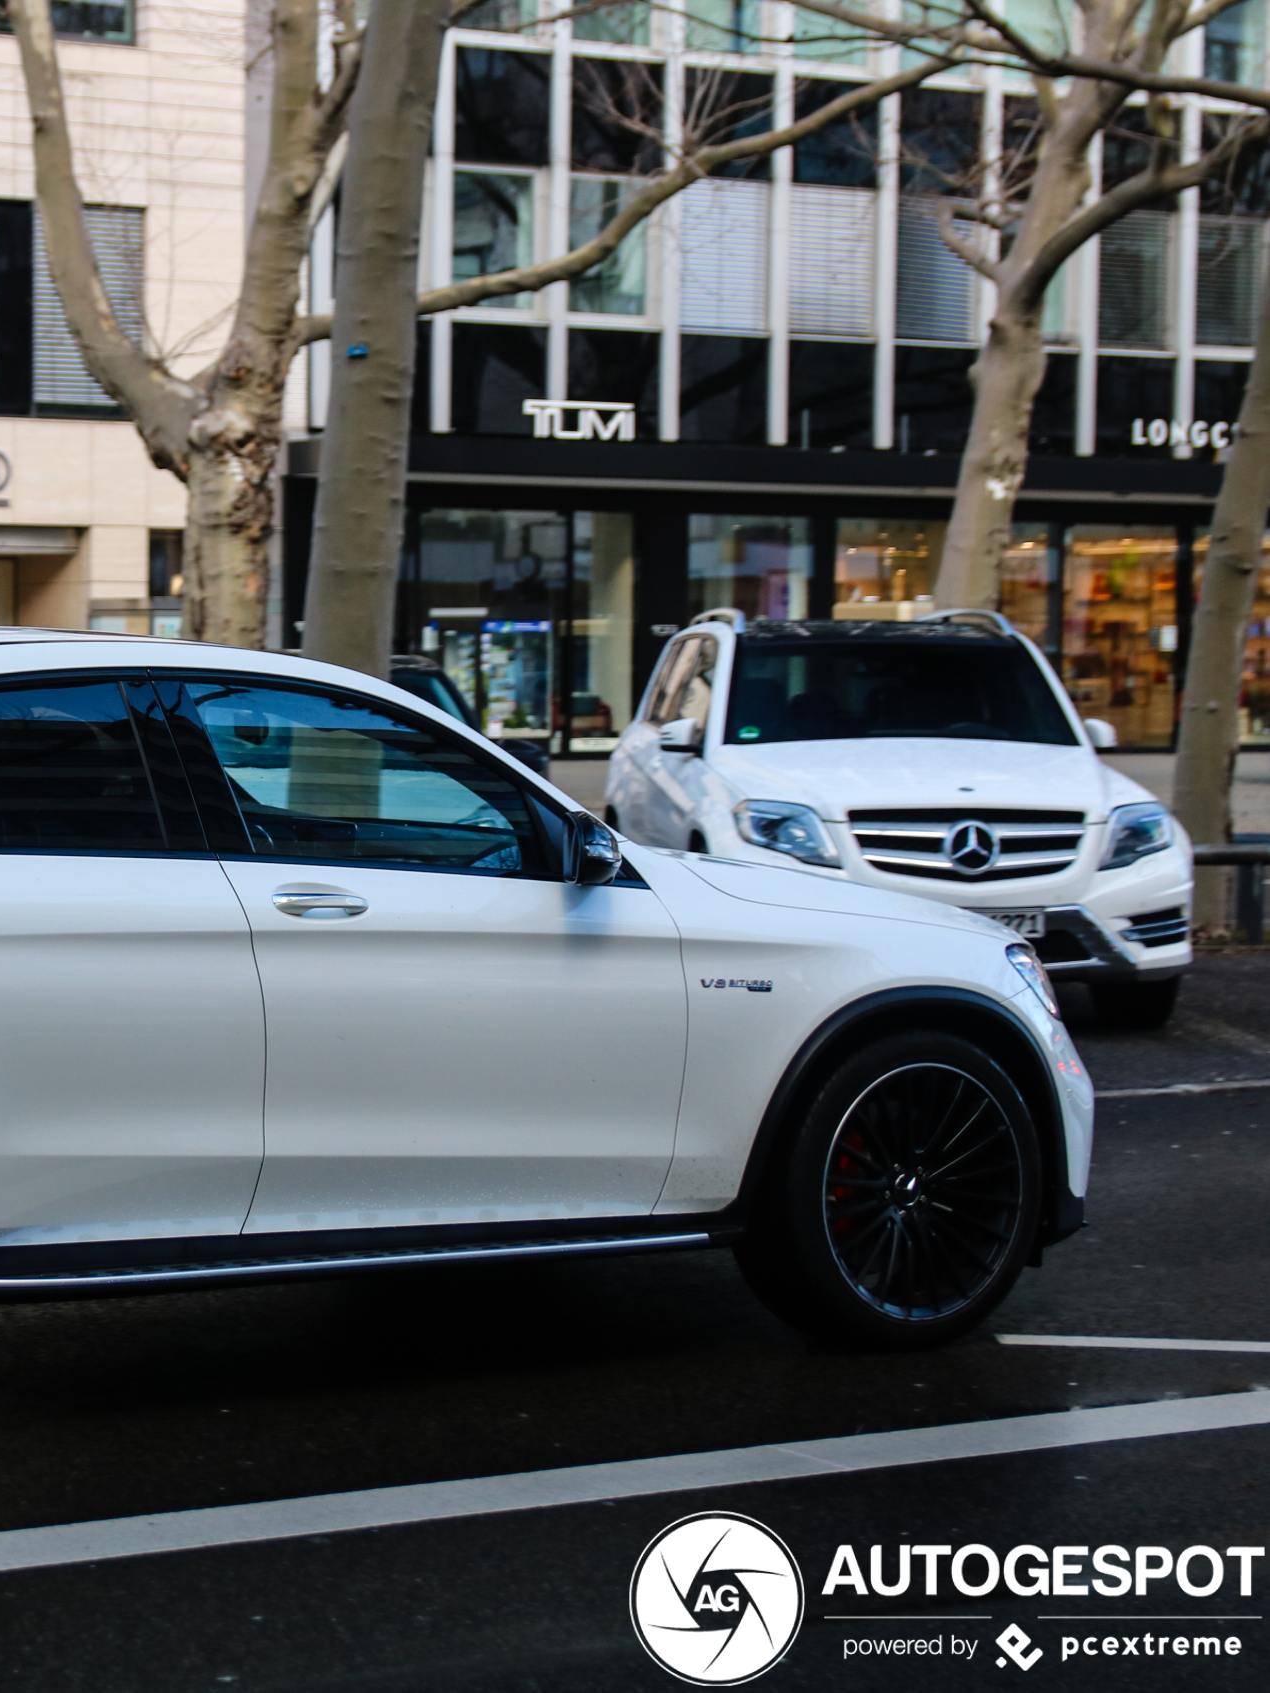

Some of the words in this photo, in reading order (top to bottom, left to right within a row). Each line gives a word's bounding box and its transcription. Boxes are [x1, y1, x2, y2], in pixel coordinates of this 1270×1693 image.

[522, 399, 635, 441] TUMI
[1131, 418, 1239, 448] LONGC
[700, 978, 726, 988] V8
[729, 978, 773, 987] BITURBO
